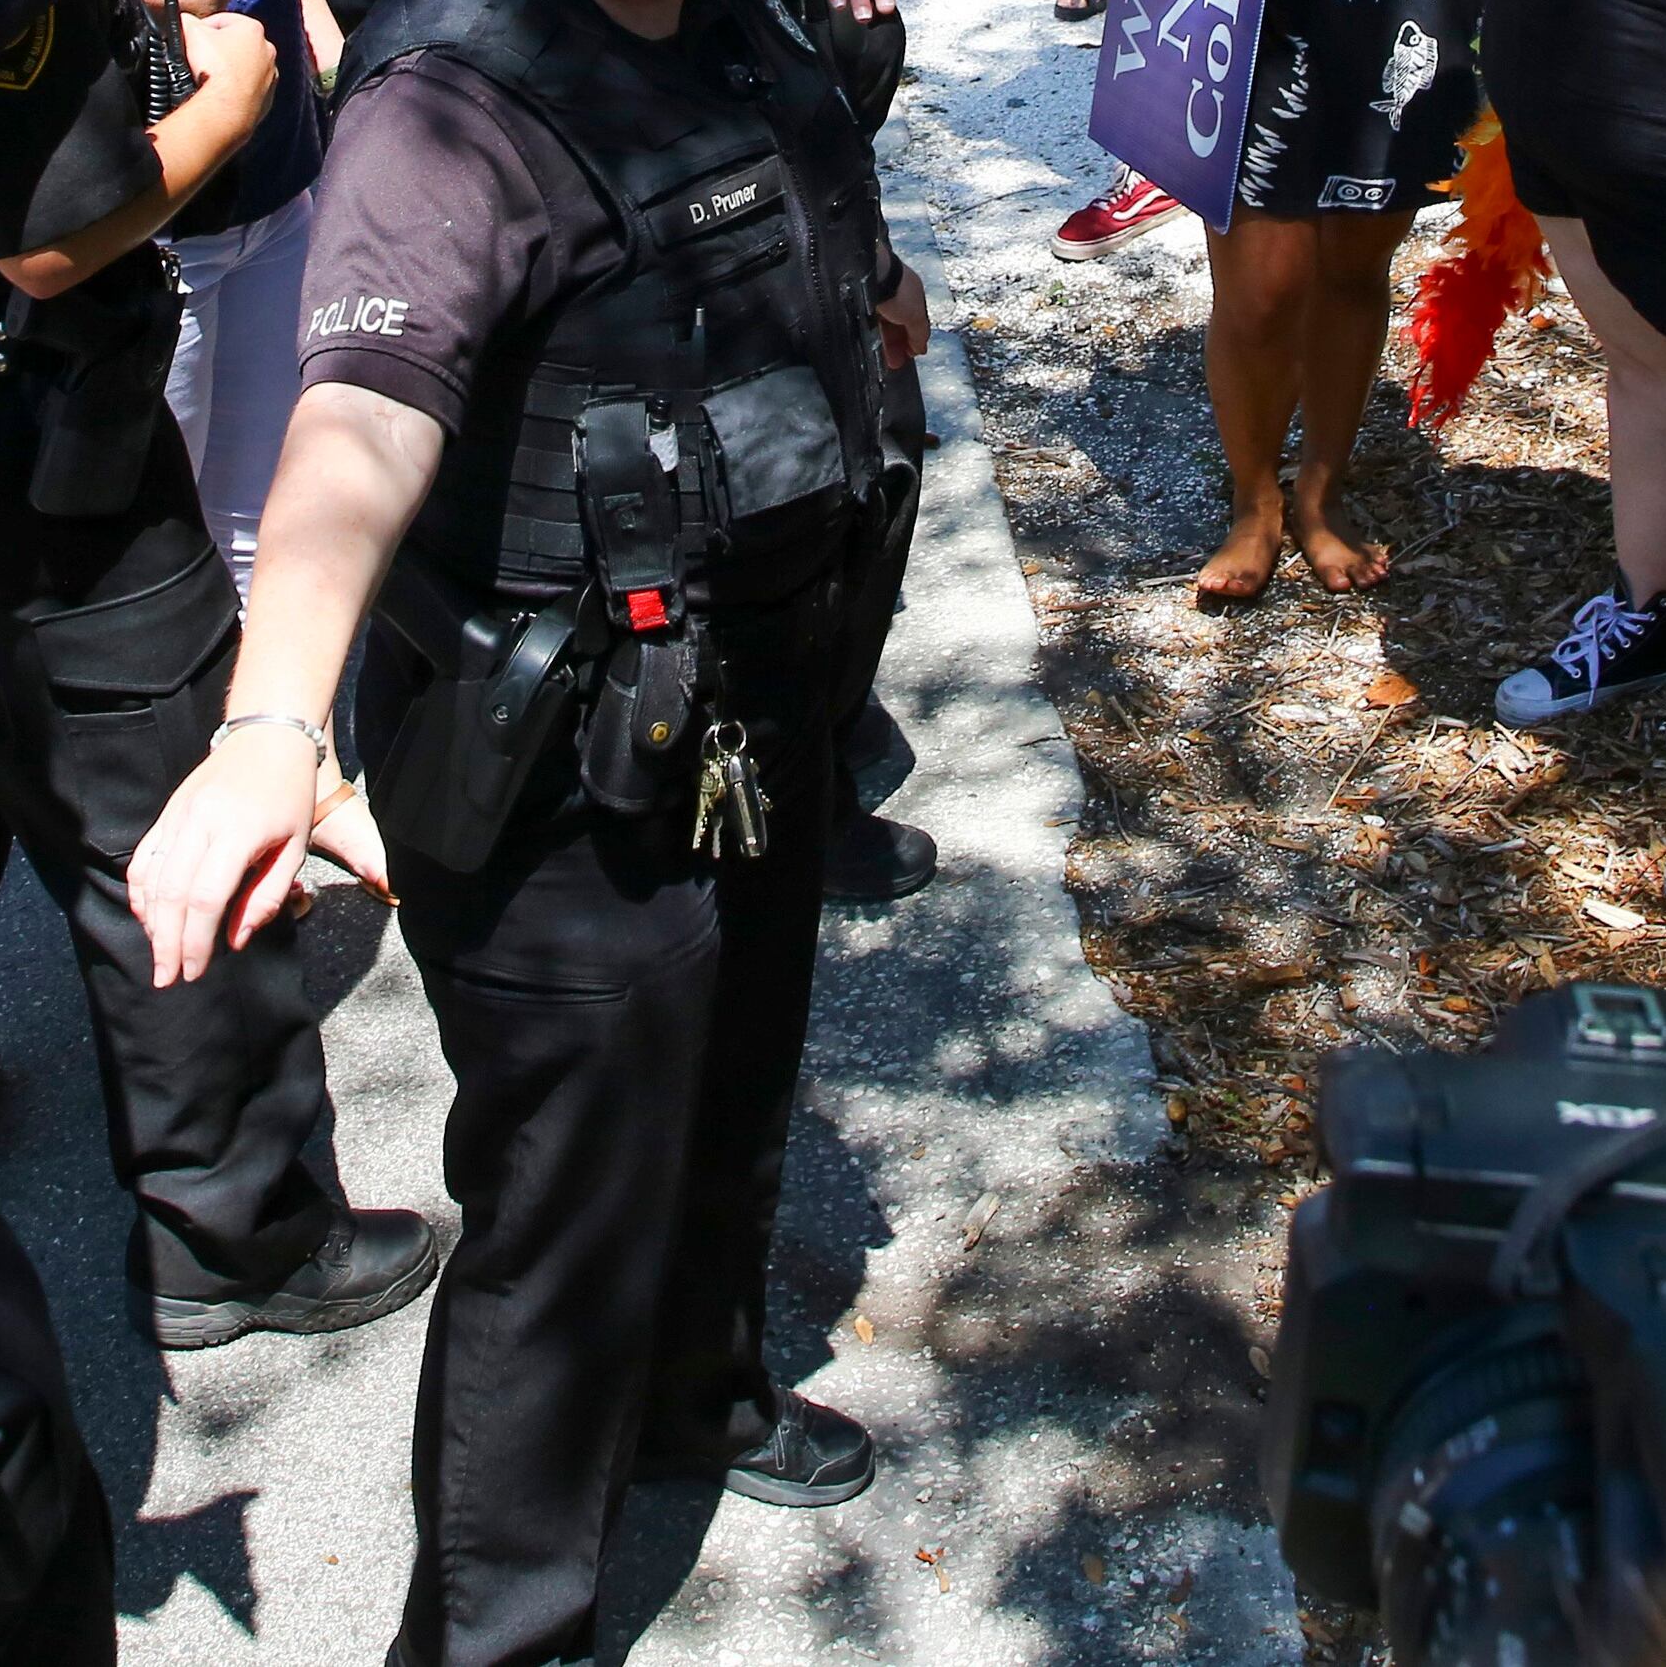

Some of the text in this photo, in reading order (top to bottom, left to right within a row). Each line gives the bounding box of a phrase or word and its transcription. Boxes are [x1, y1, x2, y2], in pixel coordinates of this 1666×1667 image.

[689, 182, 758, 225] D. Pruner
[306, 295, 410, 339] POLICE
